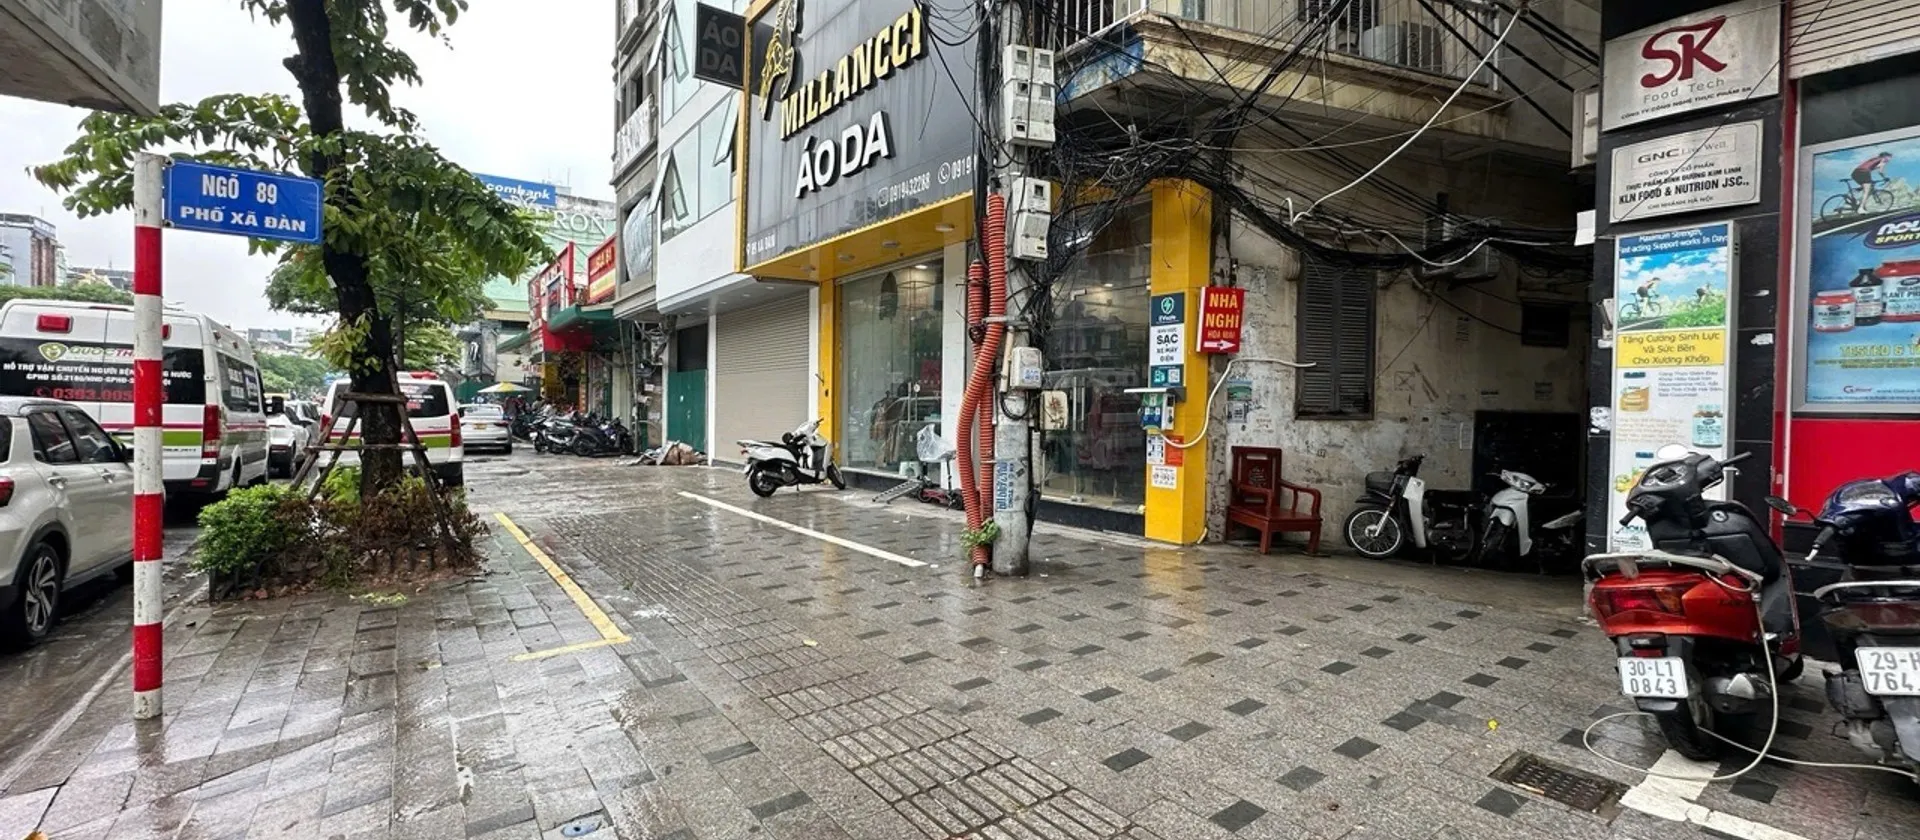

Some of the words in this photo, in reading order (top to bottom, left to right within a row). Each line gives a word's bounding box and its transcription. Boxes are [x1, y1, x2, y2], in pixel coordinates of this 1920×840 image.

[702, 15, 740, 48] ÁO
[1641, 15, 1727, 88] SK
[702, 47, 739, 77] DA
[781, 5, 923, 140] MILLANCCI
[1643, 87, 1679, 104] Food
[1687, 77, 1725, 94] Tech
[796, 136, 835, 198] ÁO
[840, 110, 889, 177] DA
[1638, 149, 1679, 163] GNC
[1708, 169, 1722, 177] KIM
[1724, 166, 1742, 174] LINH
[202, 173, 239, 199] NGÕ
[256, 181, 278, 205] 89
[485, 182, 550, 200] combank
[1618, 192, 1636, 205] KLN
[1638, 187, 1662, 201] FOOD
[1664, 186, 1671, 197] &
[1674, 179, 1719, 195] NUTRION
[179, 205, 225, 222] PHỐ
[231, 210, 258, 227] XÃ
[264, 214, 306, 233] ĐÀN
[1209, 290, 1238, 308] NHÀ
[1206, 310, 1240, 328] NGHỈ
[1156, 333, 1179, 347] SẠC
[1622, 335, 1644, 345] Tăng
[1679, 332, 1699, 341] Sinh
[1643, 344, 1655, 354] Và
[1657, 344, 1675, 353] Sức
[1677, 343, 1696, 352] Bền
[119, 368, 135, 376] BỆN
[1628, 661, 1674, 677] 30-L1
[1630, 679, 1677, 695] 0843
[1868, 672, 1920, 691] 764
